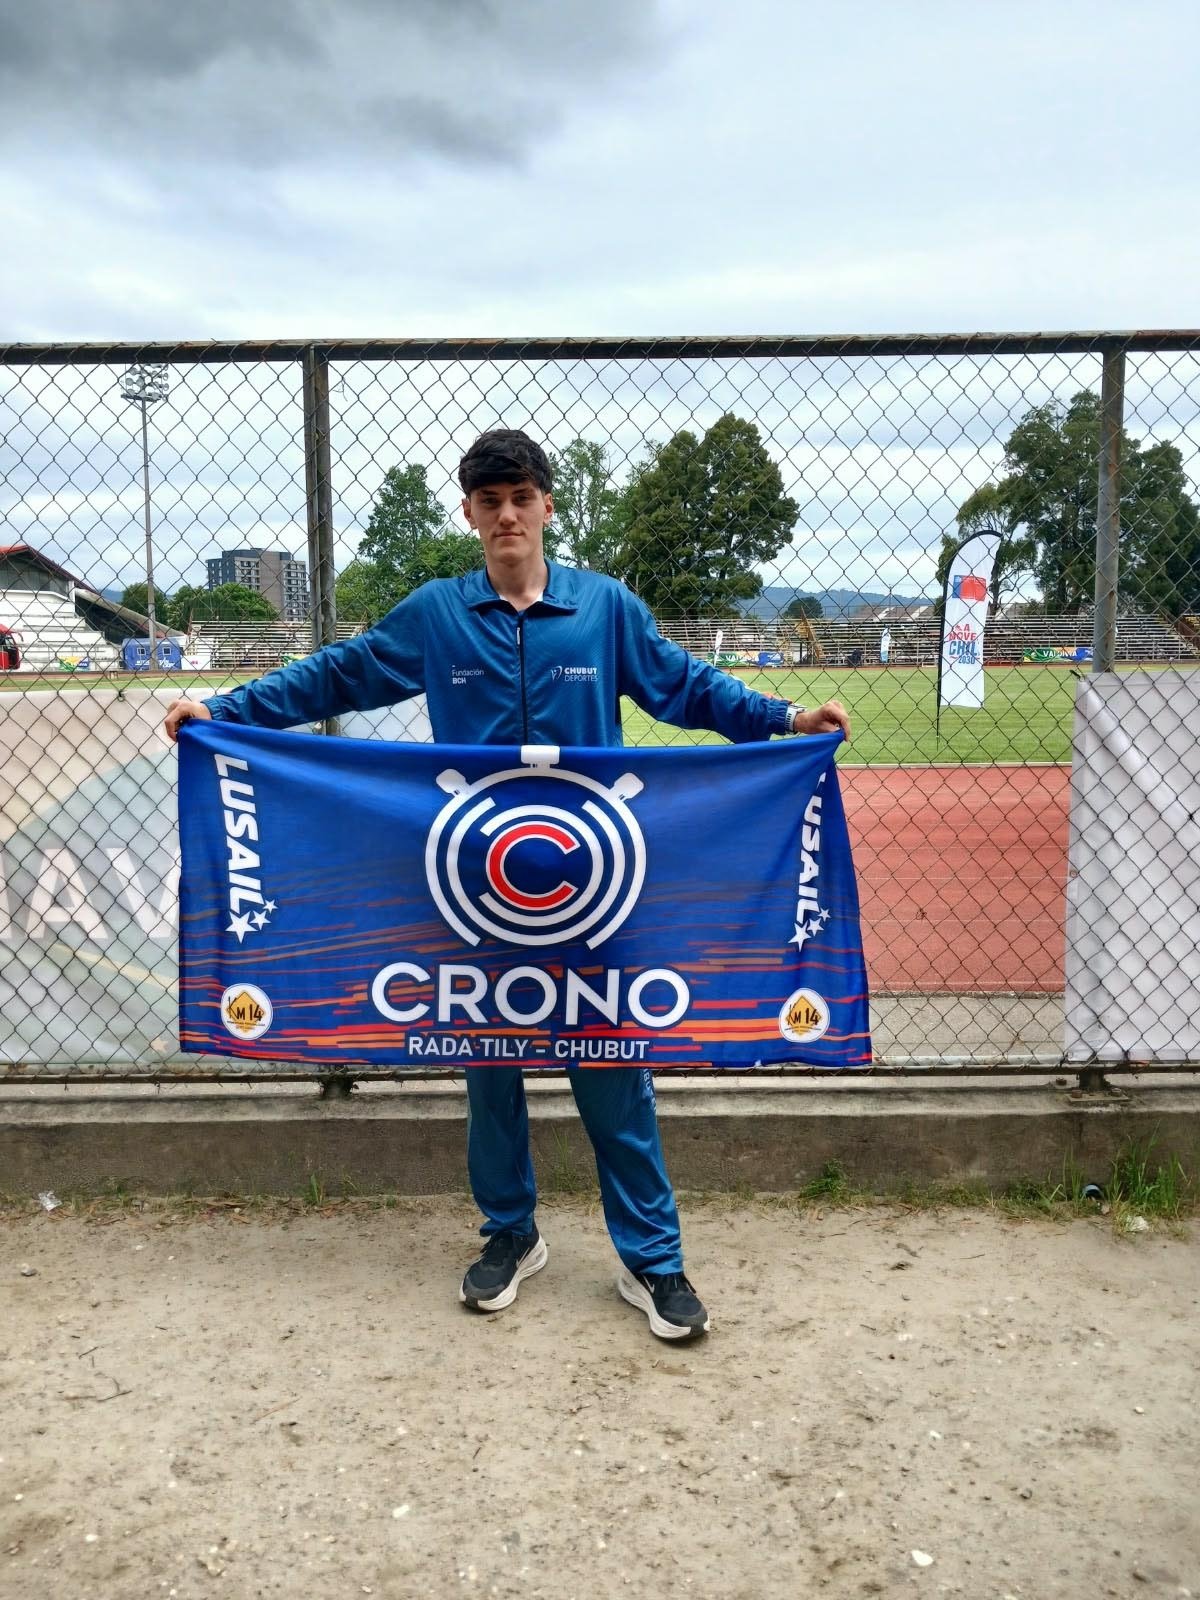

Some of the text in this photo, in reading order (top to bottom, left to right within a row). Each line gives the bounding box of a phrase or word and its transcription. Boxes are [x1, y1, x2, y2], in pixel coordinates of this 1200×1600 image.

[949, 641, 980, 656] CHIL
[959, 655, 976, 664] 2030
[564, 667, 598, 675] CHUBUT
[564, 674, 598, 682] DEPORTES
[452, 677, 467, 685] BCH
[213, 753, 264, 912] LUSAIL
[796, 771, 827, 922] USAIL
[371, 961, 690, 1028] CRONO
[805, 1007, 819, 1025] 14
[408, 1035, 474, 1057] RADA
[479, 1037, 529, 1058] TILY
[554, 1038, 650, 1059] CHUBUT
